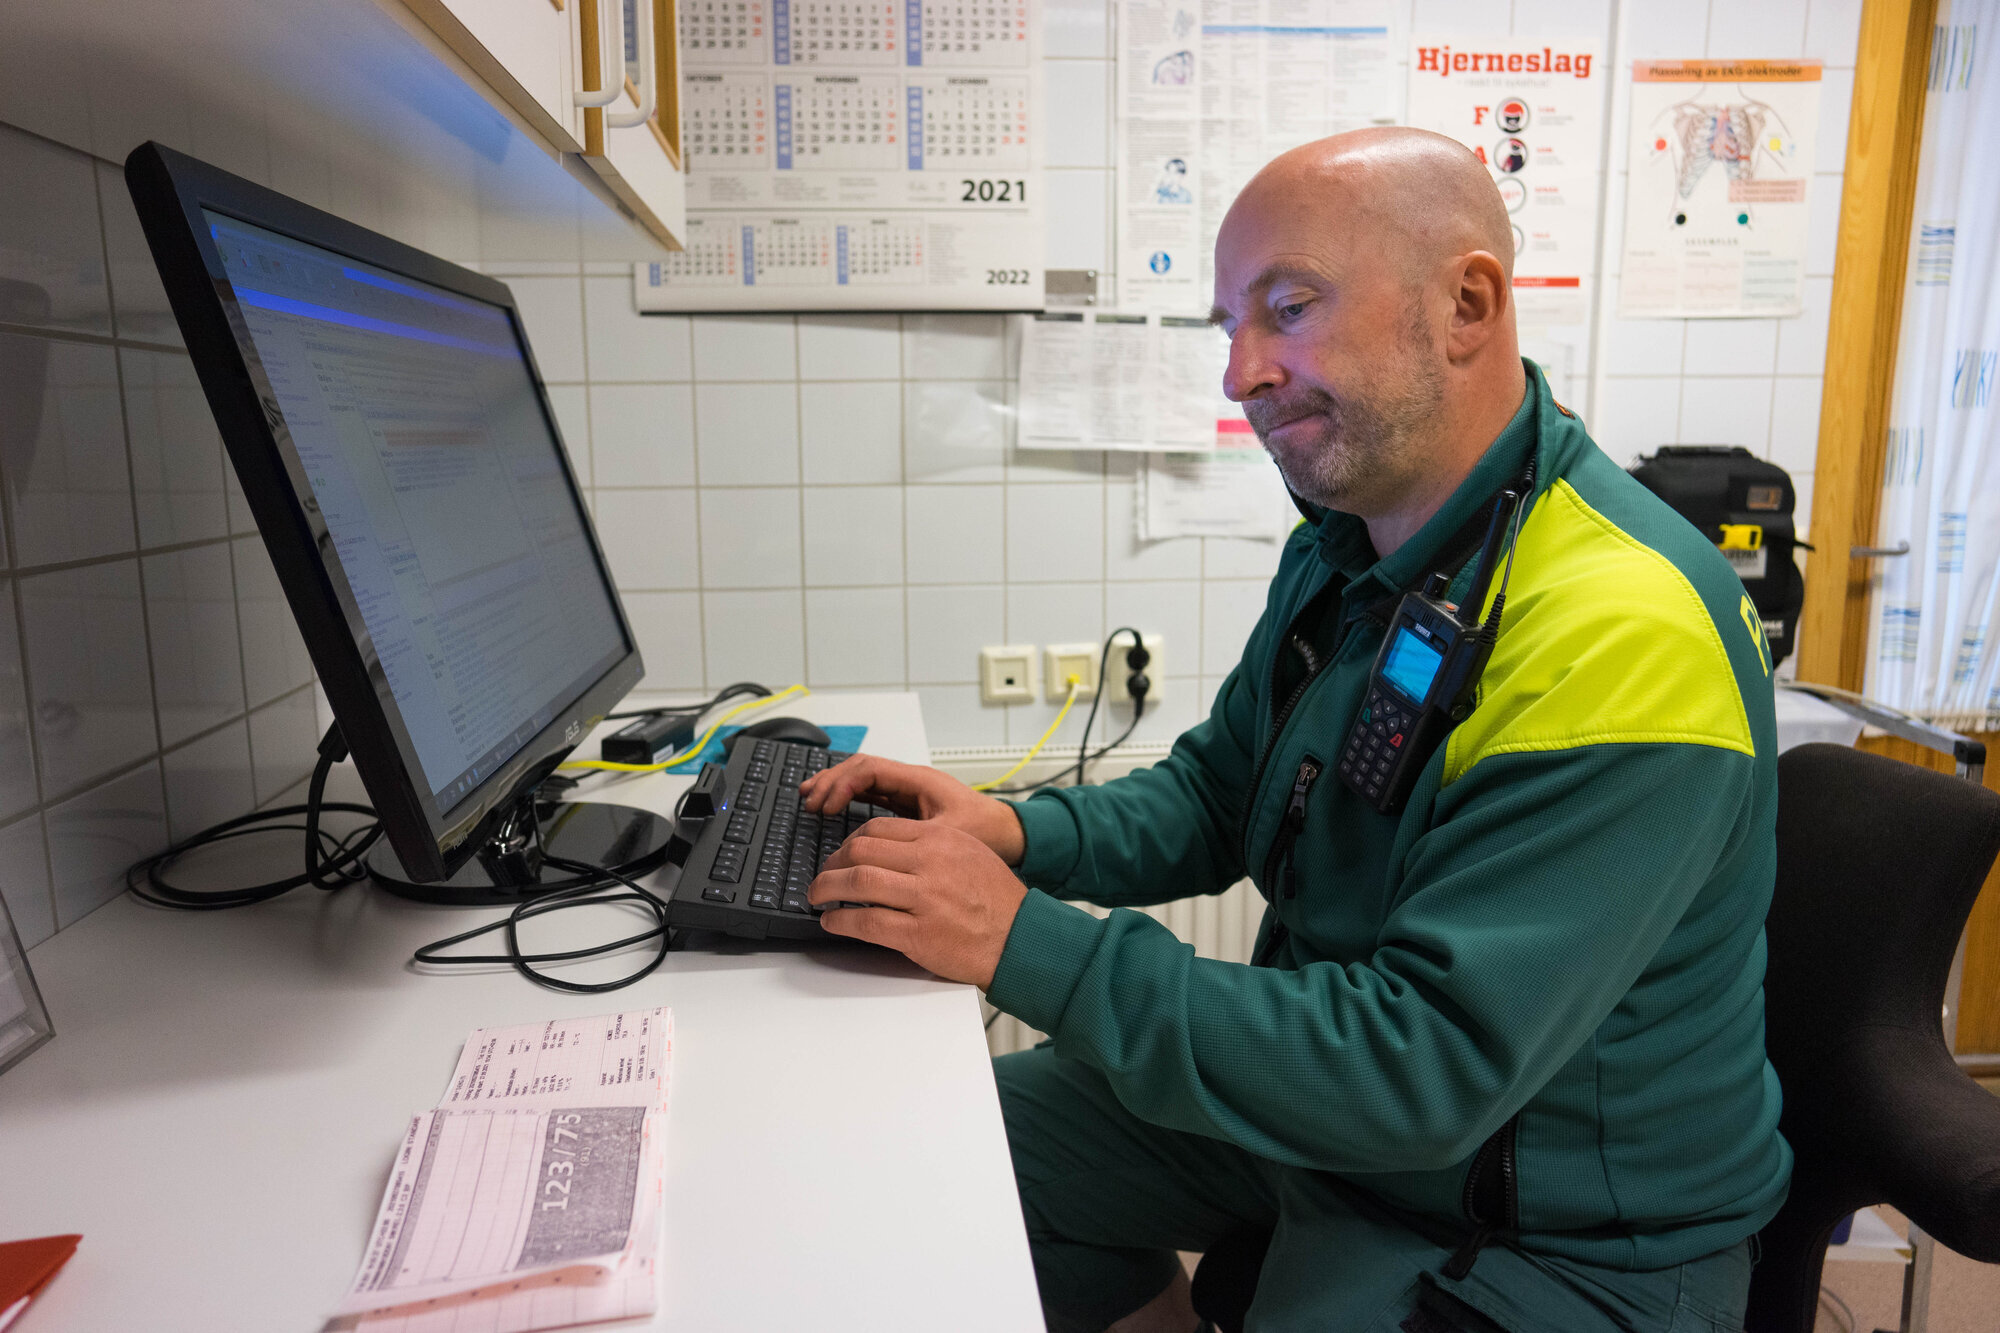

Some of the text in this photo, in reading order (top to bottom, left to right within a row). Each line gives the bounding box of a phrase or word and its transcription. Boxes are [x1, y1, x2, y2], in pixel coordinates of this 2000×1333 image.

[1417, 46, 1592, 78] Hjerneslag
[1474, 106, 1490, 125] F
[961, 180, 1026, 202] 2021
[986, 270, 1030, 285] 2022
[542, 1114, 582, 1211] 123/75
